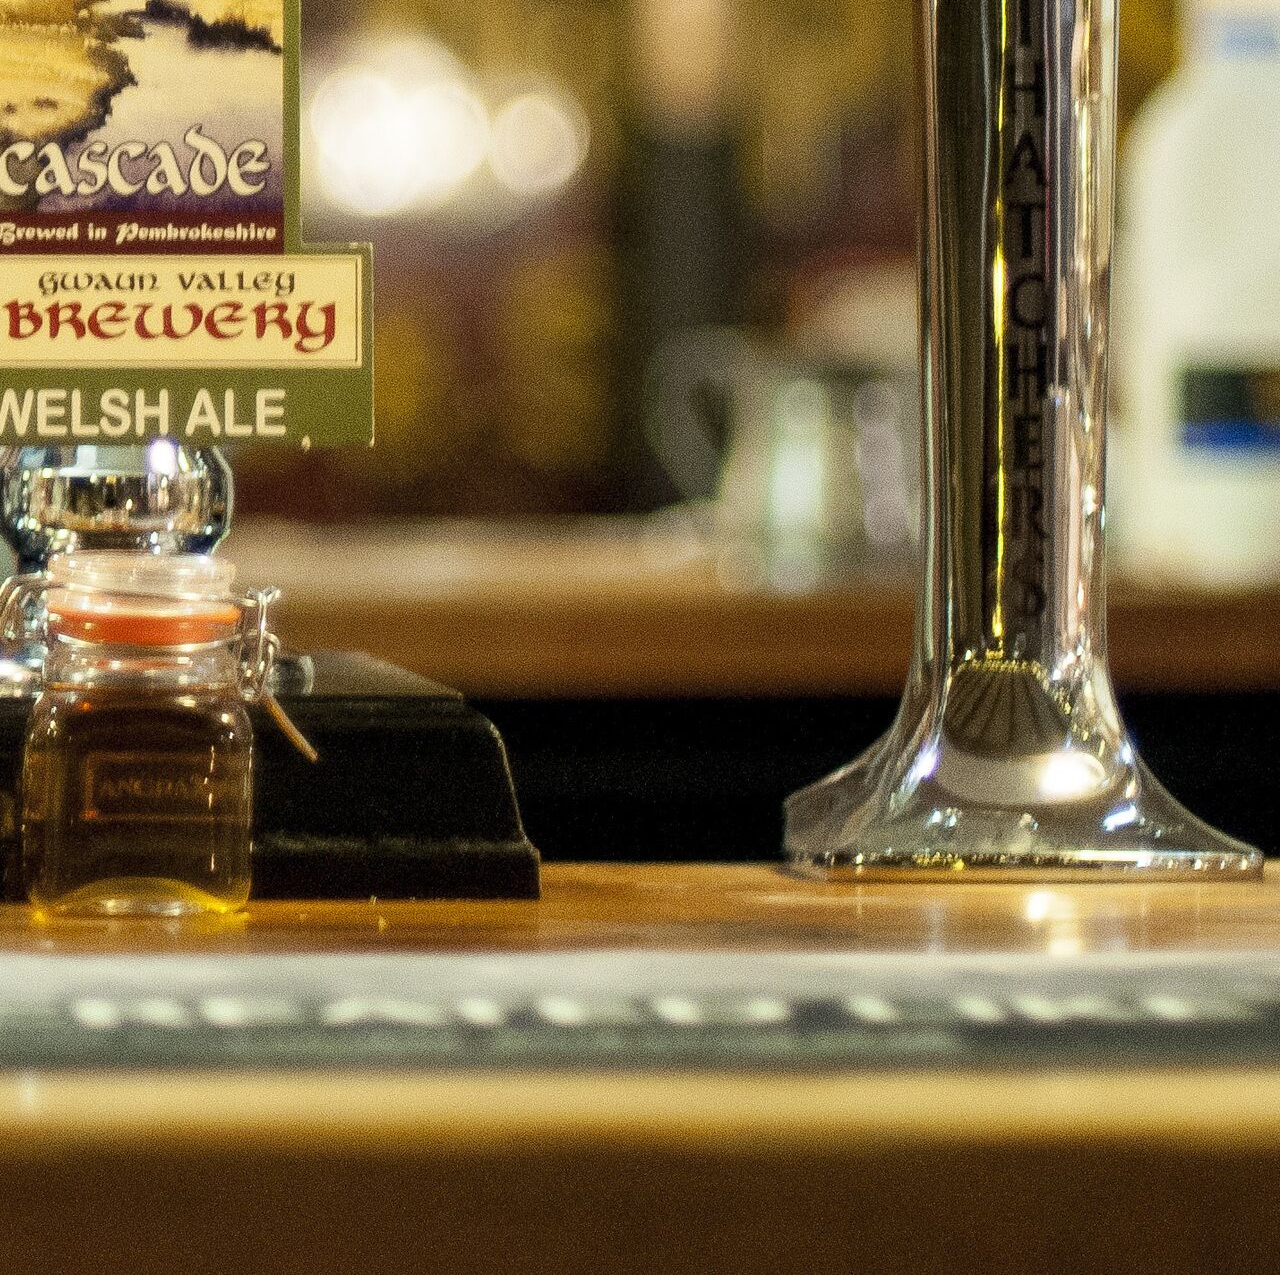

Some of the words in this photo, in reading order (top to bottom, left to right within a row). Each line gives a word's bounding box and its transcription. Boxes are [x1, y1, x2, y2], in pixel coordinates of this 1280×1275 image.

[88, 222, 108, 241] in
[115, 221, 277, 246] Pembrokeshire
[2, 299, 336, 355] BREWERY
[185, 388, 287, 437] ALE
